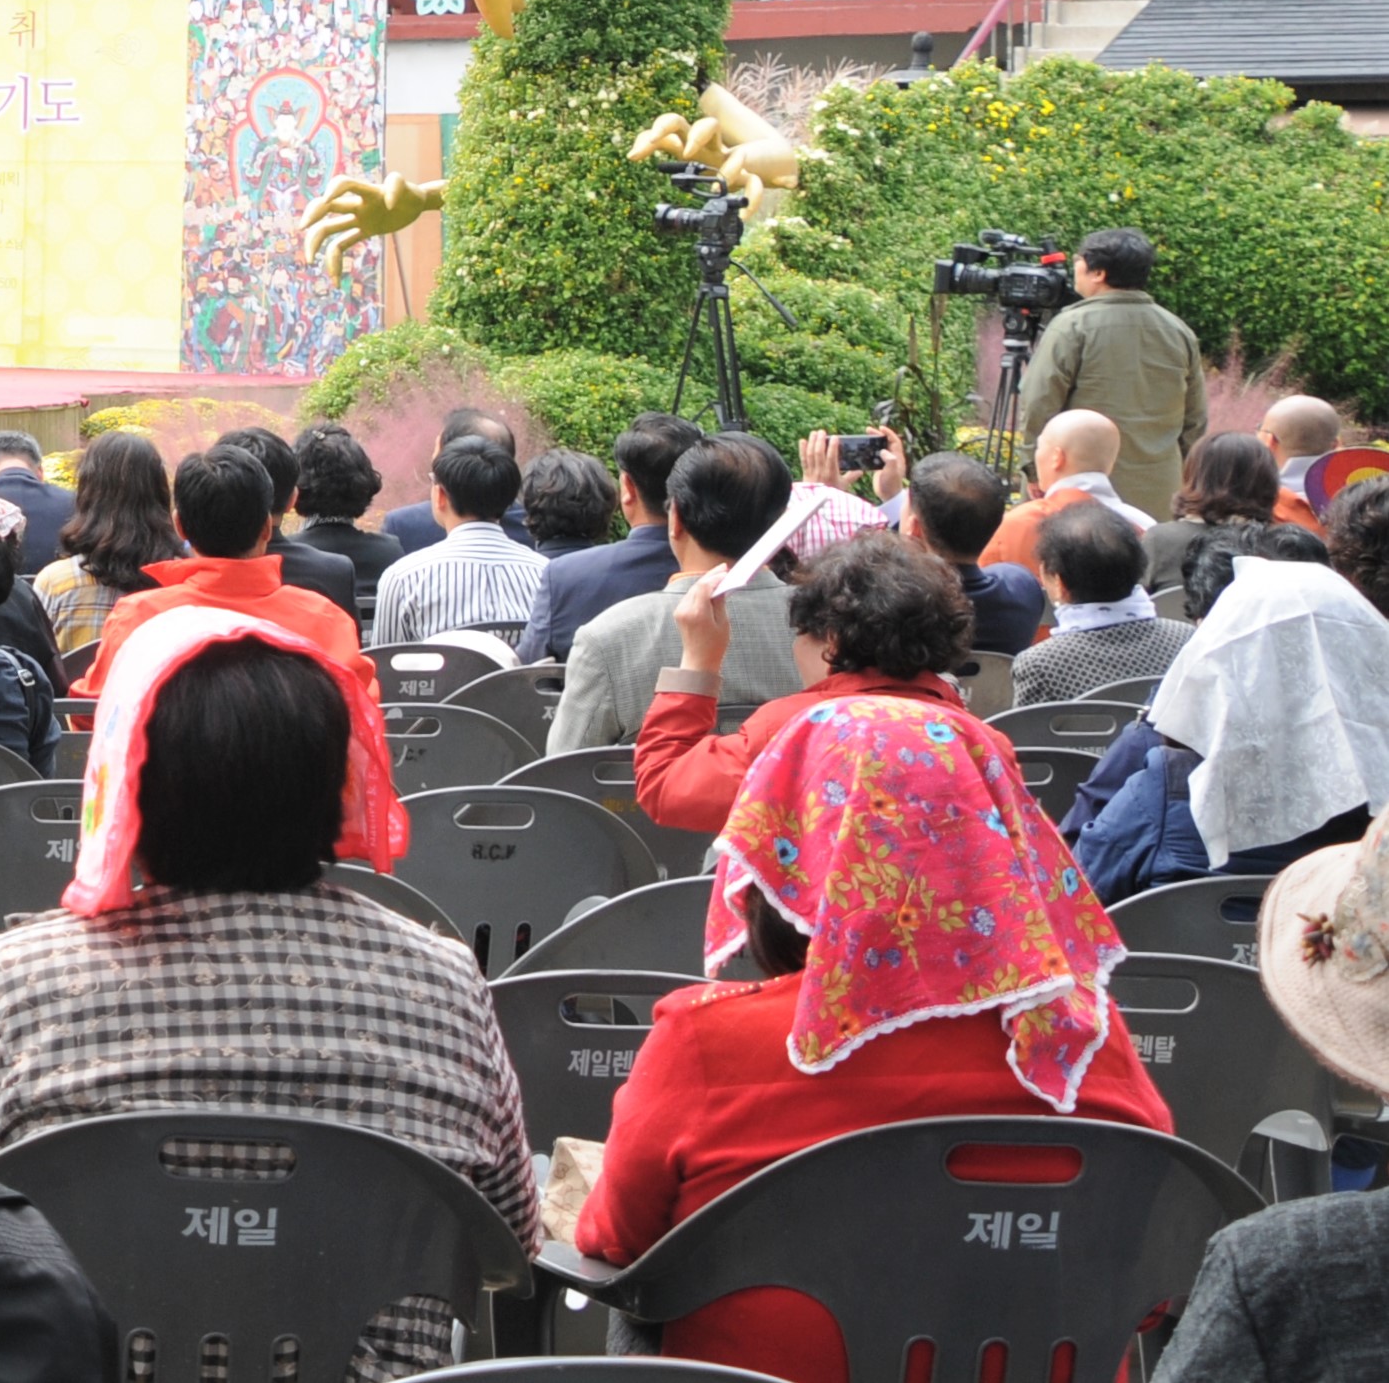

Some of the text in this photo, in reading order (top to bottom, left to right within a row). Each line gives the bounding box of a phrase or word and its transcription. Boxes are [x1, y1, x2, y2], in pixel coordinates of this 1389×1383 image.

[399, 680, 436, 696] 제일
[181, 1207, 279, 1247] 제일
[963, 1210, 1061, 1251] 제일
